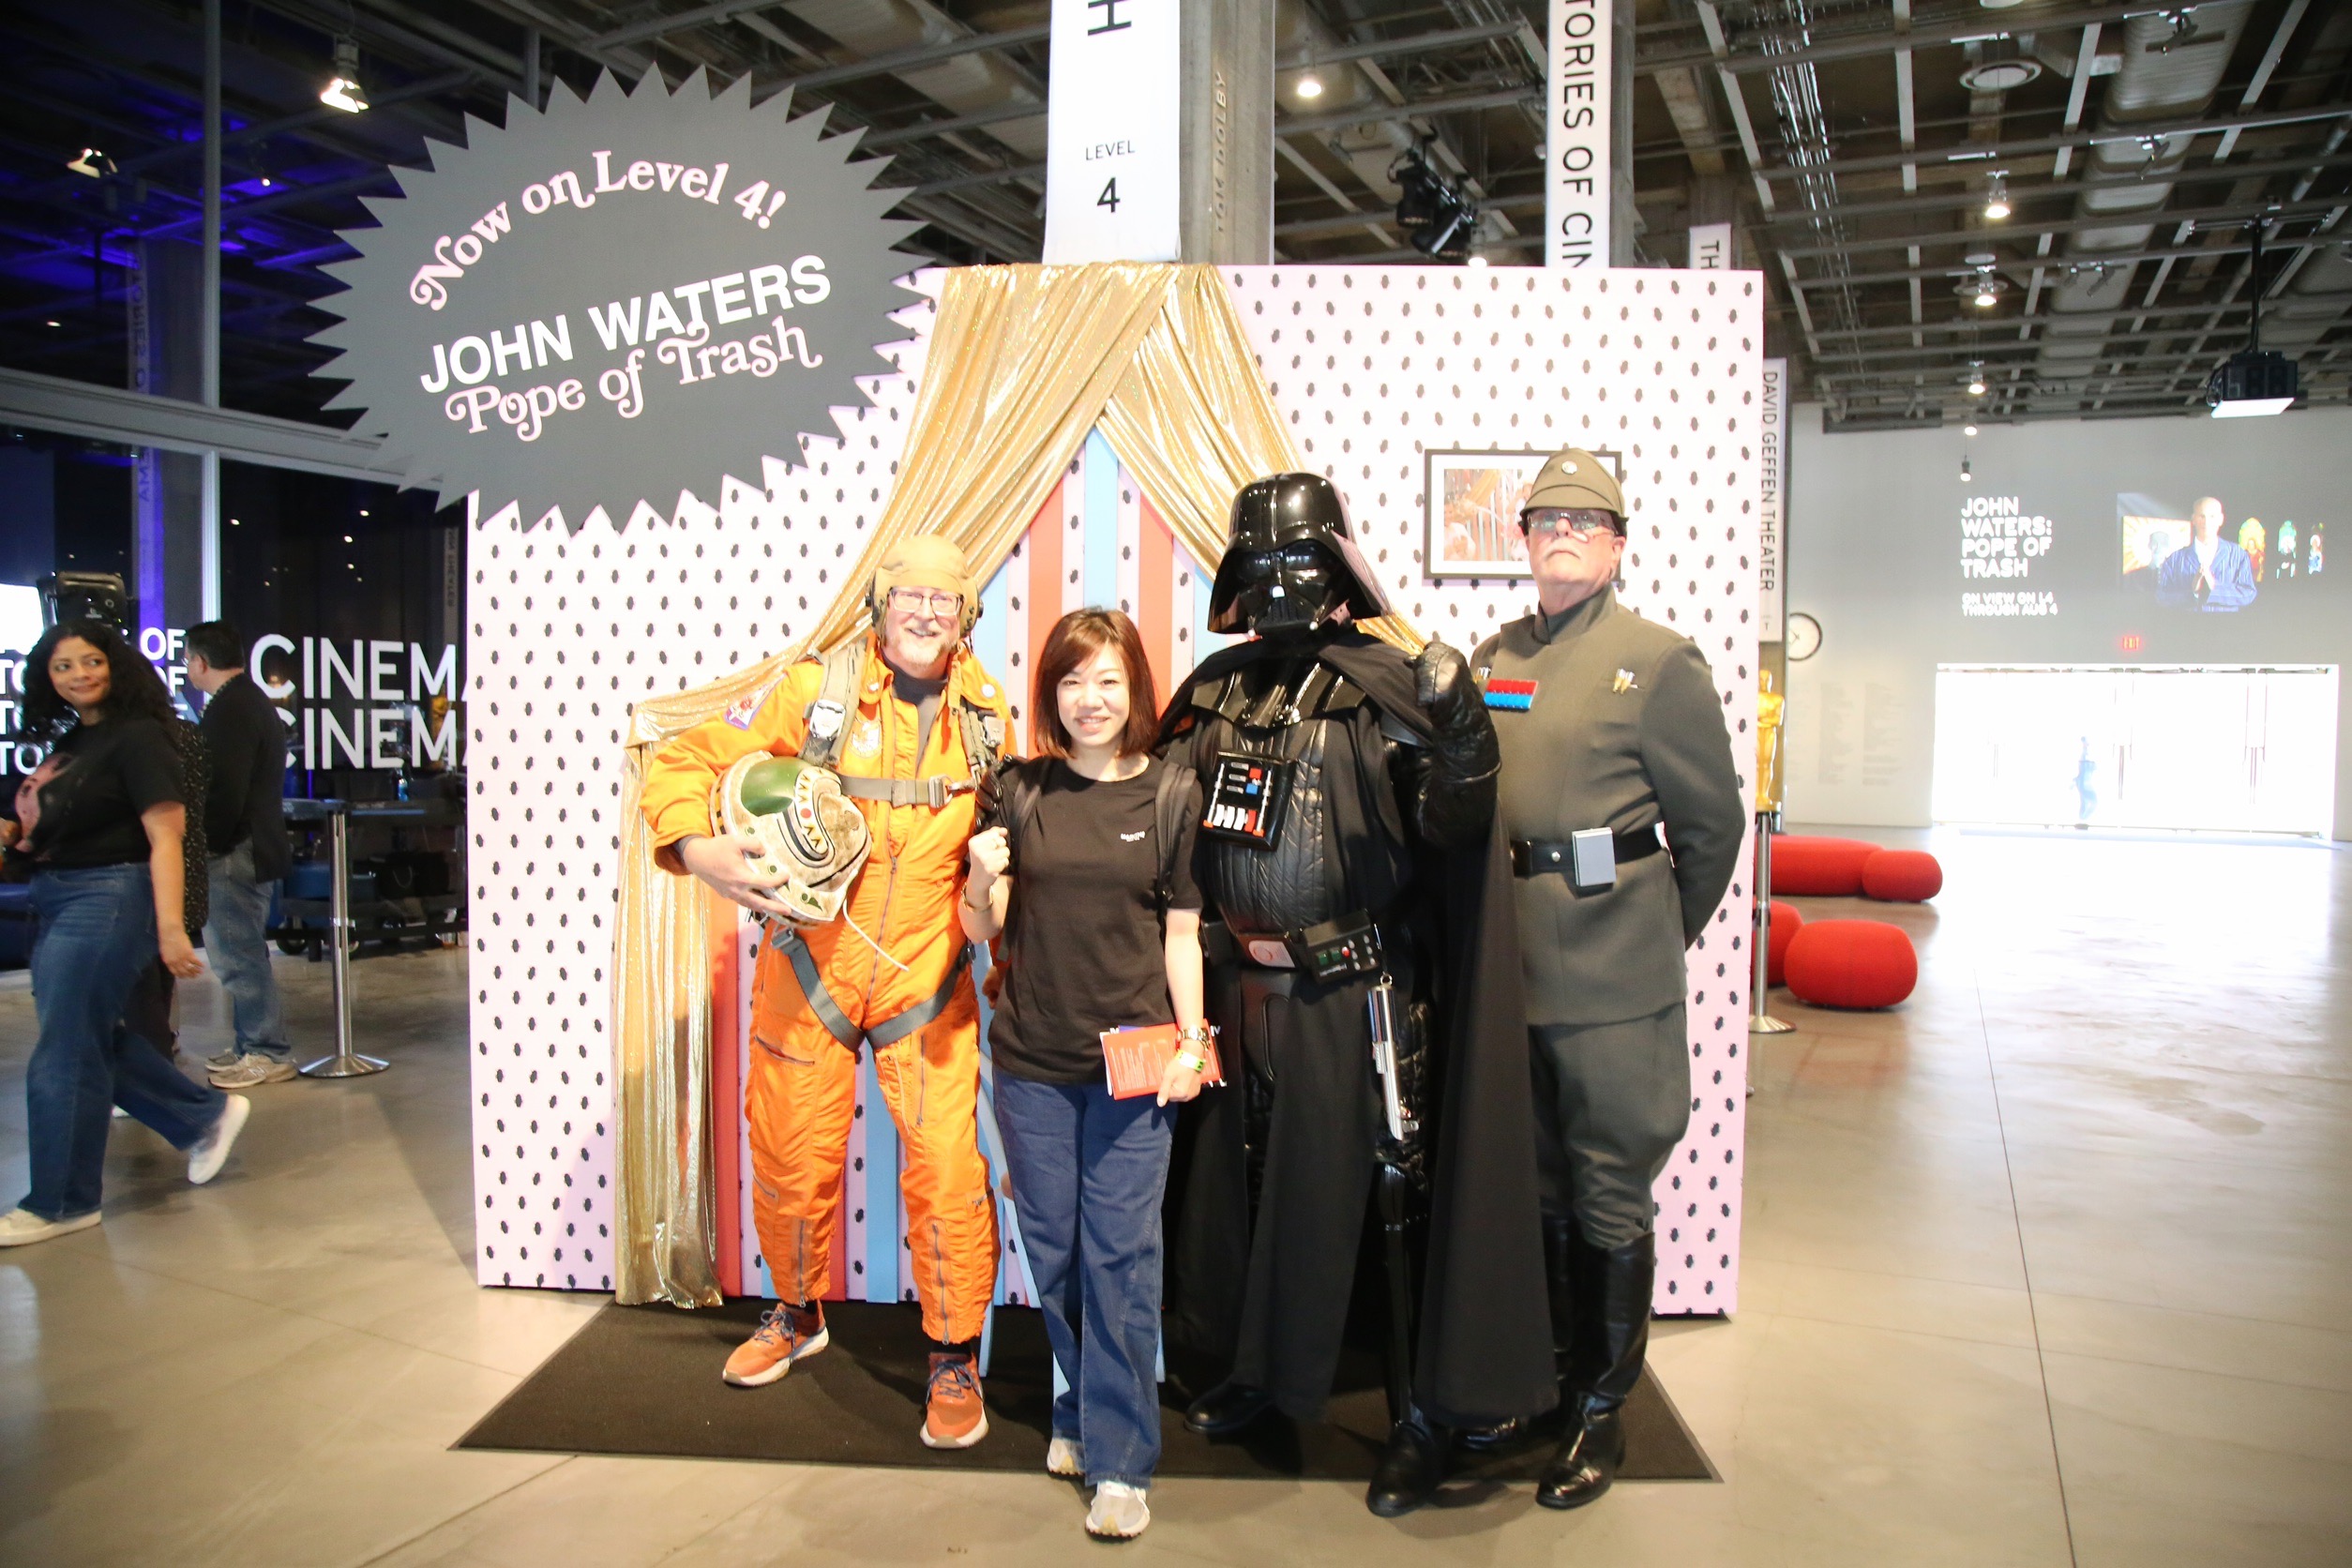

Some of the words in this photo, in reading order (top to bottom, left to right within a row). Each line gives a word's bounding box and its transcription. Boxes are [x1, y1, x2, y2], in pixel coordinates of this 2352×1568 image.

[1214, 70, 1228, 166] DOLBY
[1085, 141, 1136, 160] LEVEL
[1562, 146, 1593, 196] OF
[1096, 176, 1121, 214] 4
[410, 201, 512, 311] Now
[521, 171, 596, 215] on
[592, 150, 730, 205] Level
[733, 180, 787, 230] 4!
[420, 314, 574, 394] JOHN
[587, 254, 831, 352] WATERS
[445, 379, 586, 443] Pope
[598, 348, 646, 419] of
[656, 315, 823, 385] Trash
[1762, 371, 1778, 424] DAVID
[1761, 432, 1777, 503] GEFFEN
[1960, 496, 2019, 518] JOHN
[1960, 516, 2053, 538] WATERS:
[1759, 509, 1776, 592] THEATER
[1960, 557, 2028, 579] TRASH
[1961, 537, 2018, 558] POPE
[2023, 536, 2053, 557] OF
[1961, 603, 2020, 616] THROUGH
[1962, 593, 1981, 605] ON
[1982, 593, 2015, 605] VIEW
[2016, 592, 2036, 605] ON
[140, 626, 187, 661] OF
[250, 633, 467, 702] CINEM
[275, 706, 467, 771] INEM
